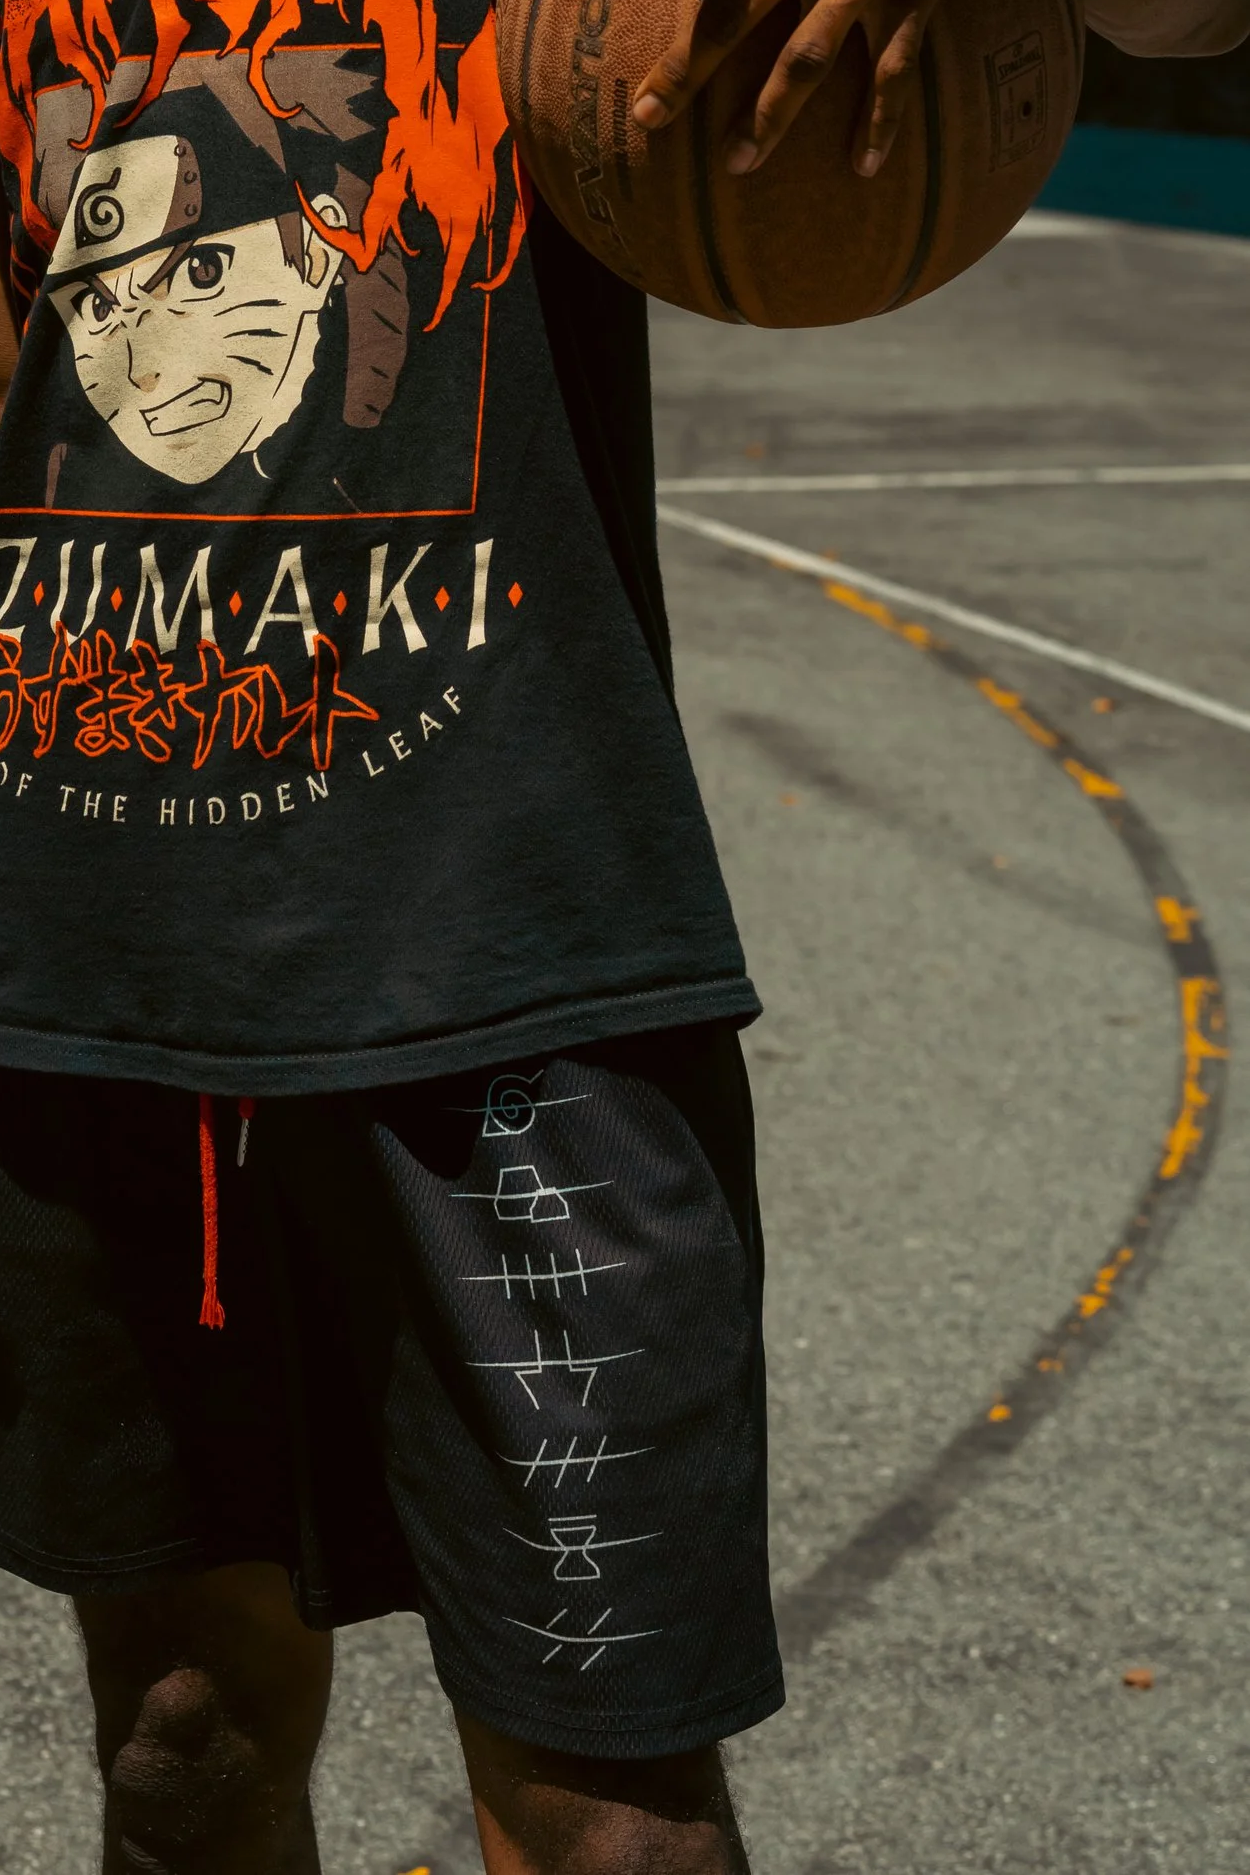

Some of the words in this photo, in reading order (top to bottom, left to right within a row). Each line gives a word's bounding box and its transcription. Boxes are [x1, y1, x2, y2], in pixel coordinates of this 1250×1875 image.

[58, 783, 128, 824] THE
[159, 771, 330, 826] HIDDEN
[361, 685, 464, 778] LEAF
